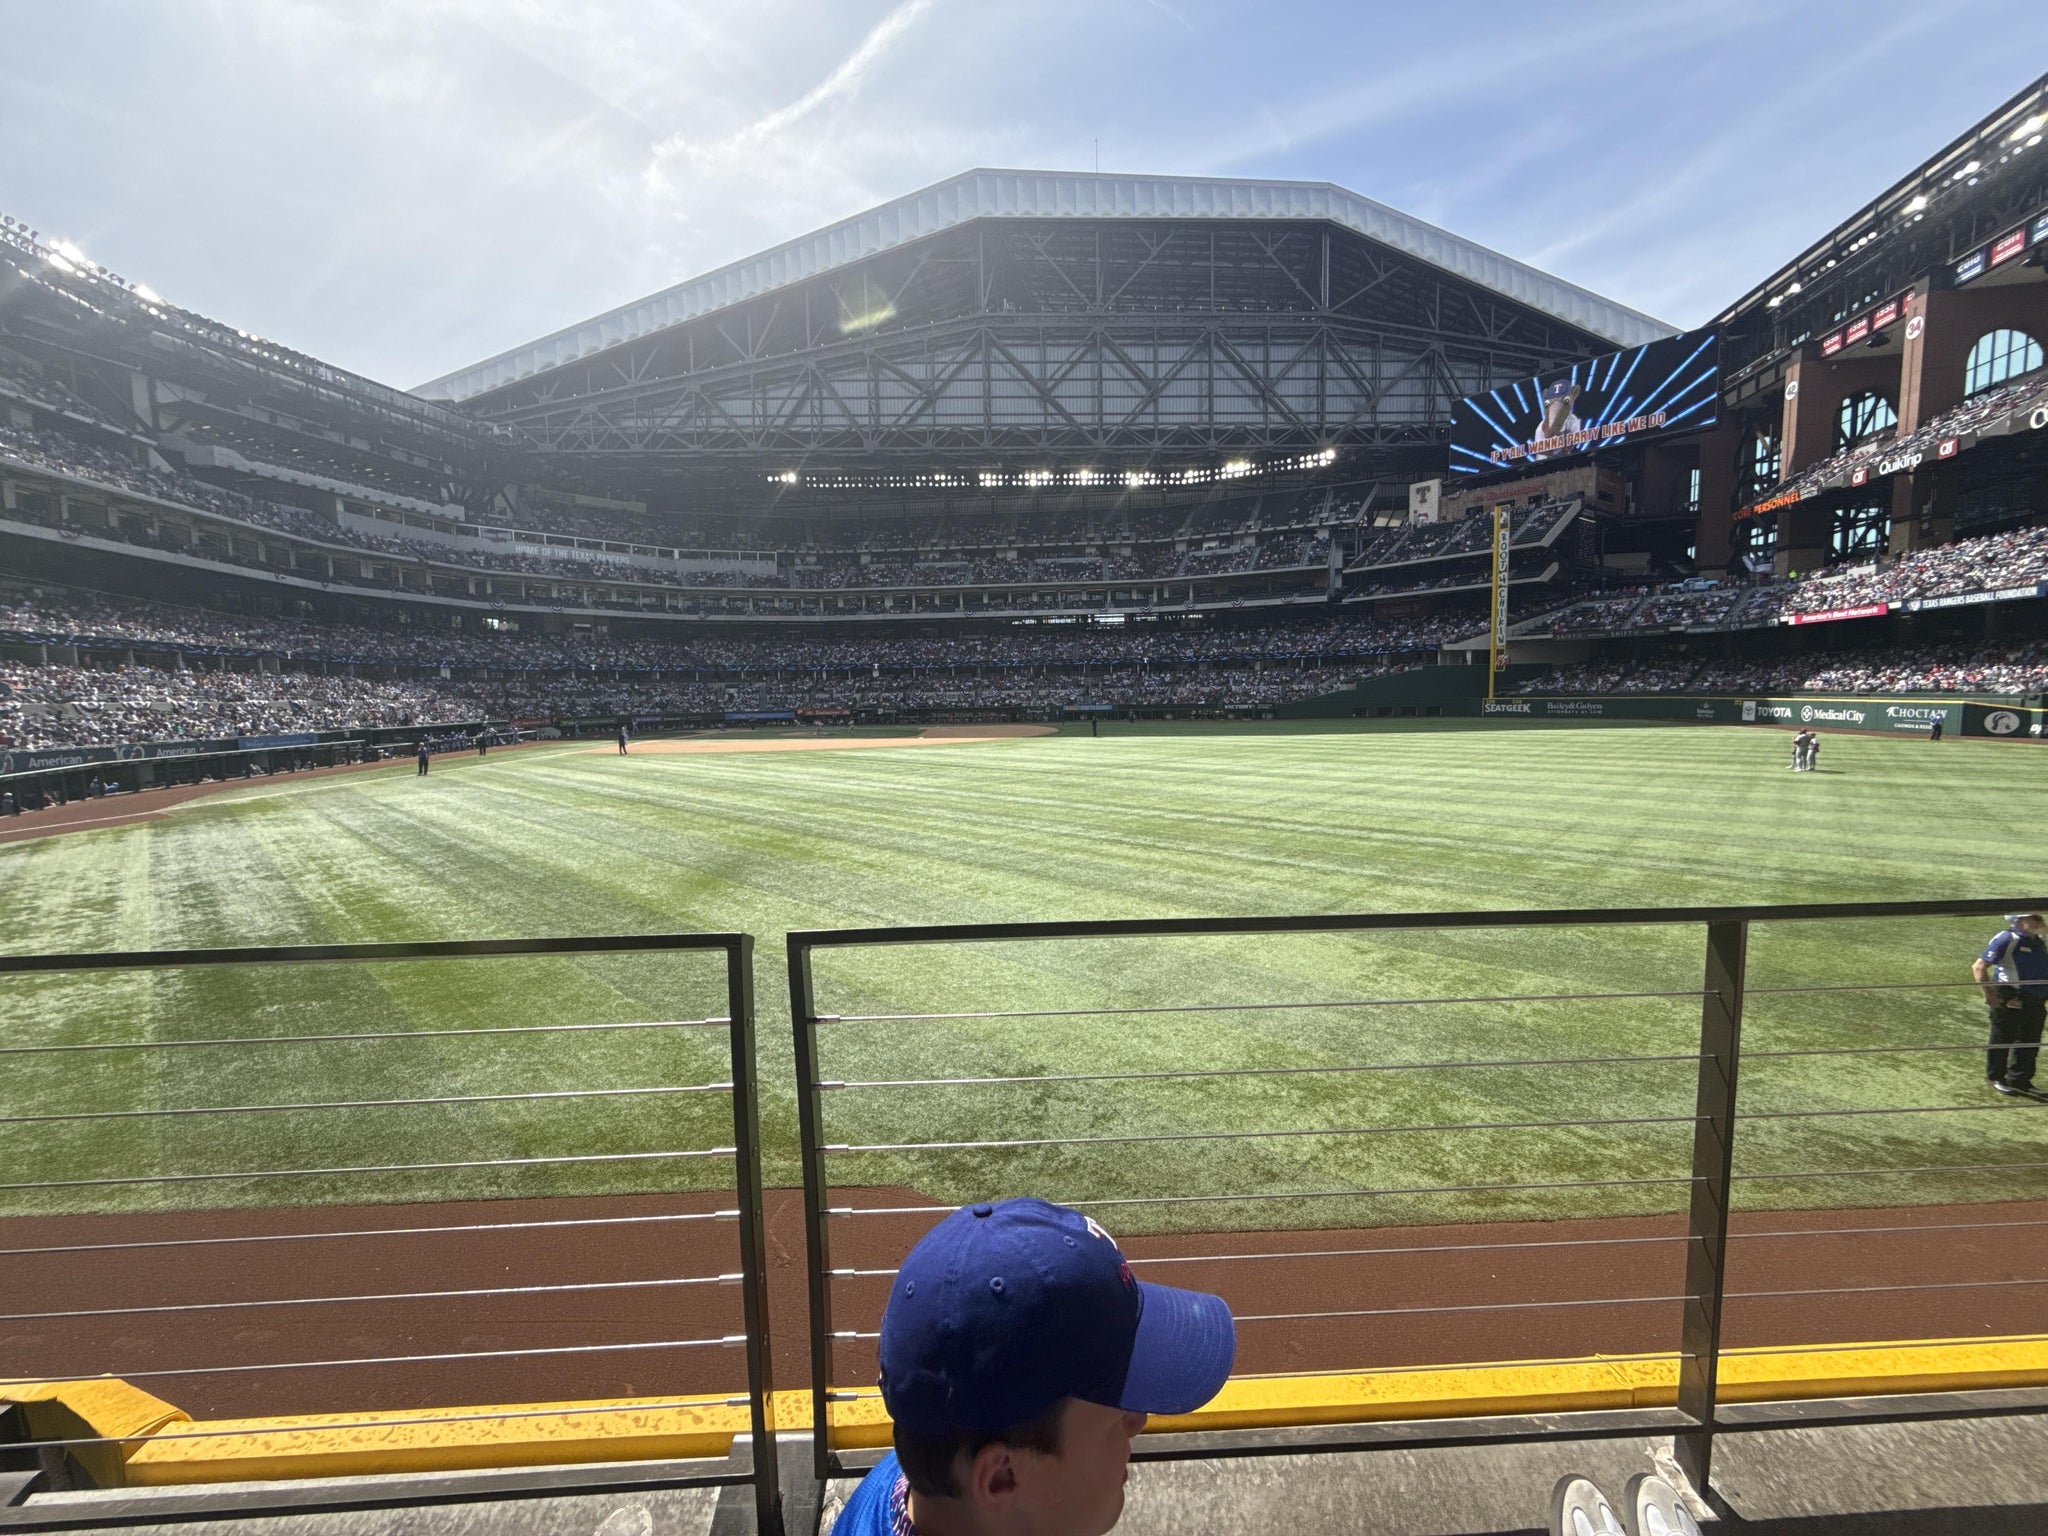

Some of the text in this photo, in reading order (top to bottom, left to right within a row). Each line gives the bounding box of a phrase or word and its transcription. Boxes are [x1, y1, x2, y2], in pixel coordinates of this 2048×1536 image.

[1908, 322, 1922, 336] 34
[1786, 384, 1797, 396] 42
[1490, 411, 1667, 463] IF Y'ALL WANNA PARTY LIKE WE DO
[1939, 440, 1955, 455] QT
[1879, 453, 1922, 475] QuikTrip
[1852, 470, 1865, 483] QT
[1732, 507, 1752, 520] CORE
[1753, 492, 1800, 514] PERSONNEL
[515, 545, 630, 565] HOME OF THE TEXAS RANGERS
[1500, 533, 1508, 571] ROOT
[1923, 586, 2038, 609] TEXAS RANGERS BASEBALL FOUNDATION
[1801, 612, 1832, 622] America's
[1849, 607, 1879, 617] Network
[1485, 703, 1531, 713] SEATGEEK
[1757, 706, 1792, 718] TOYOTA
[1813, 709, 1866, 724] Medical City
[156, 746, 197, 757] American
[28, 755, 83, 768] American
